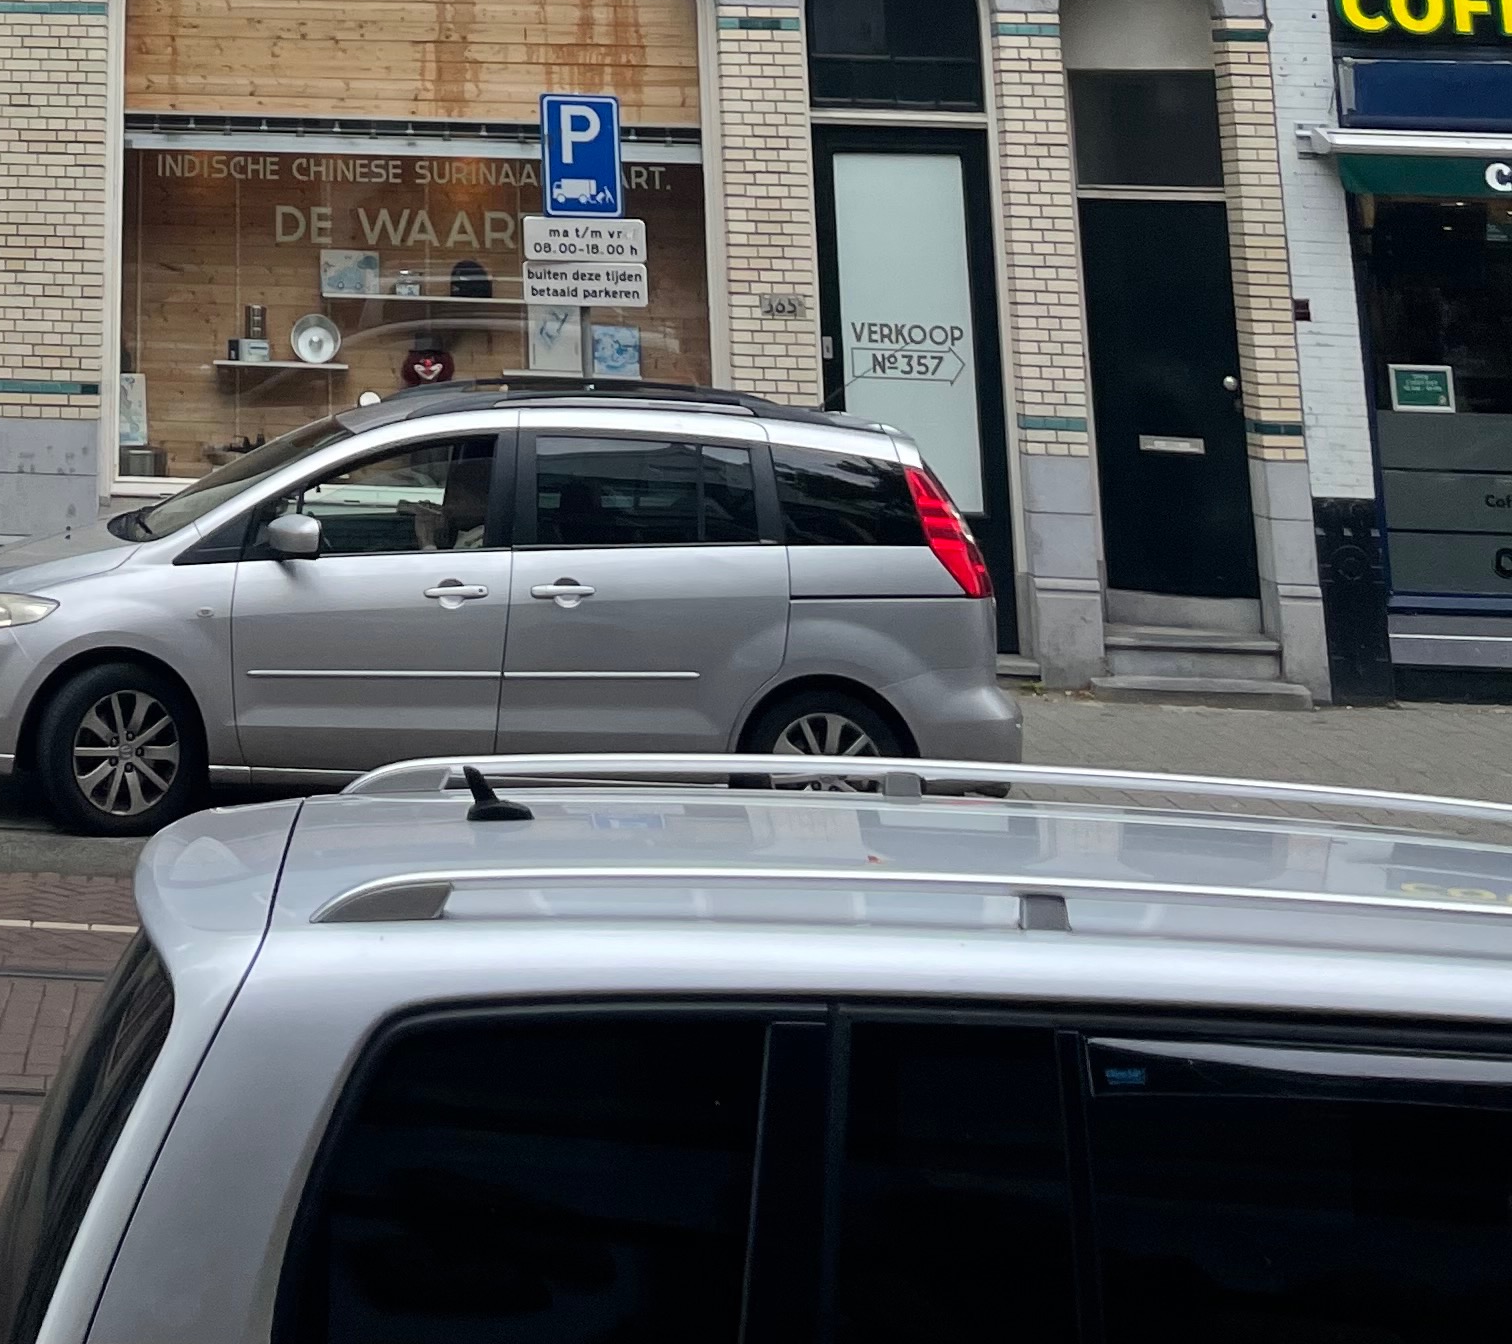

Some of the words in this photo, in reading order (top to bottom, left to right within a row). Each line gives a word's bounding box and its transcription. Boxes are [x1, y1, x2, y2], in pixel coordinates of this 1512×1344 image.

[560, 104, 601, 164] P
[157, 153, 280, 180] INDISCHE
[292, 158, 402, 183] CHINESE
[415, 161, 544, 187] SURINAA
[275, 205, 332, 244] DE
[357, 207, 542, 249] WAAR
[548, 228, 569, 238] ma
[575, 227, 602, 239] t/m
[607, 230, 623, 239] vr
[533, 242, 625, 255] 08.00-18.00
[629, 244, 638, 255] h
[528, 269, 568, 280] buiten
[572, 270, 601, 281] deze
[606, 271, 642, 285] tijden
[531, 285, 578, 297] betaald
[583, 287, 640, 299] parkeren
[851, 322, 964, 346] VERKOOP
